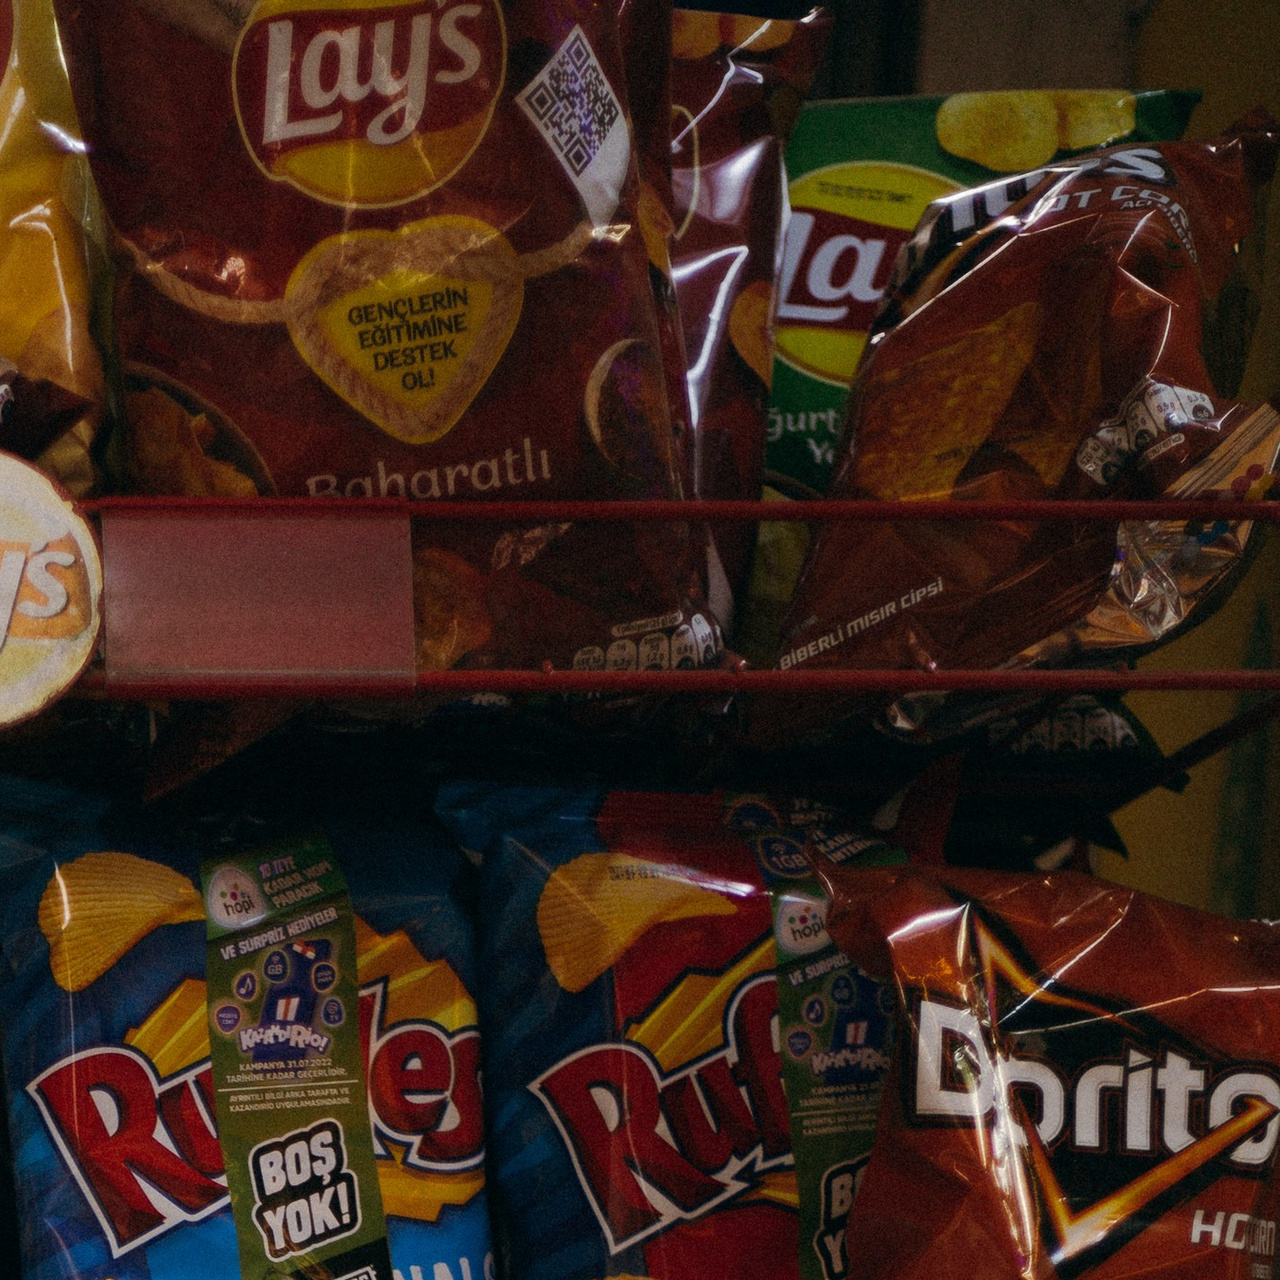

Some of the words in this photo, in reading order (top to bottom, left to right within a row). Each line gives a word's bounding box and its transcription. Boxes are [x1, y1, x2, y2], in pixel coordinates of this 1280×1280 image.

[347, 286, 469, 327] GENÇLERİN
[358, 312, 468, 350] EĞİTİMİNE
[373, 340, 459, 373] DESTEK
[401, 371, 437, 392] OL!
[780, 625, 845, 672] BİBERLİ
[897, 575, 945, 615] CİPSİ
[223, 894, 256, 917] hopi
[220, 944, 237, 961] VE
[286, 906, 339, 938] HEDİYELER
[225, 1072, 266, 1084] TARİHİNE
[238, 1061, 286, 1072] KAMPANYA
[285, 1057, 333, 1068] 31.07.2022
[916, 999, 1280, 1165] Dorito
[258, 1130, 338, 1197] BOŞ
[262, 1181, 351, 1251] YOK!
